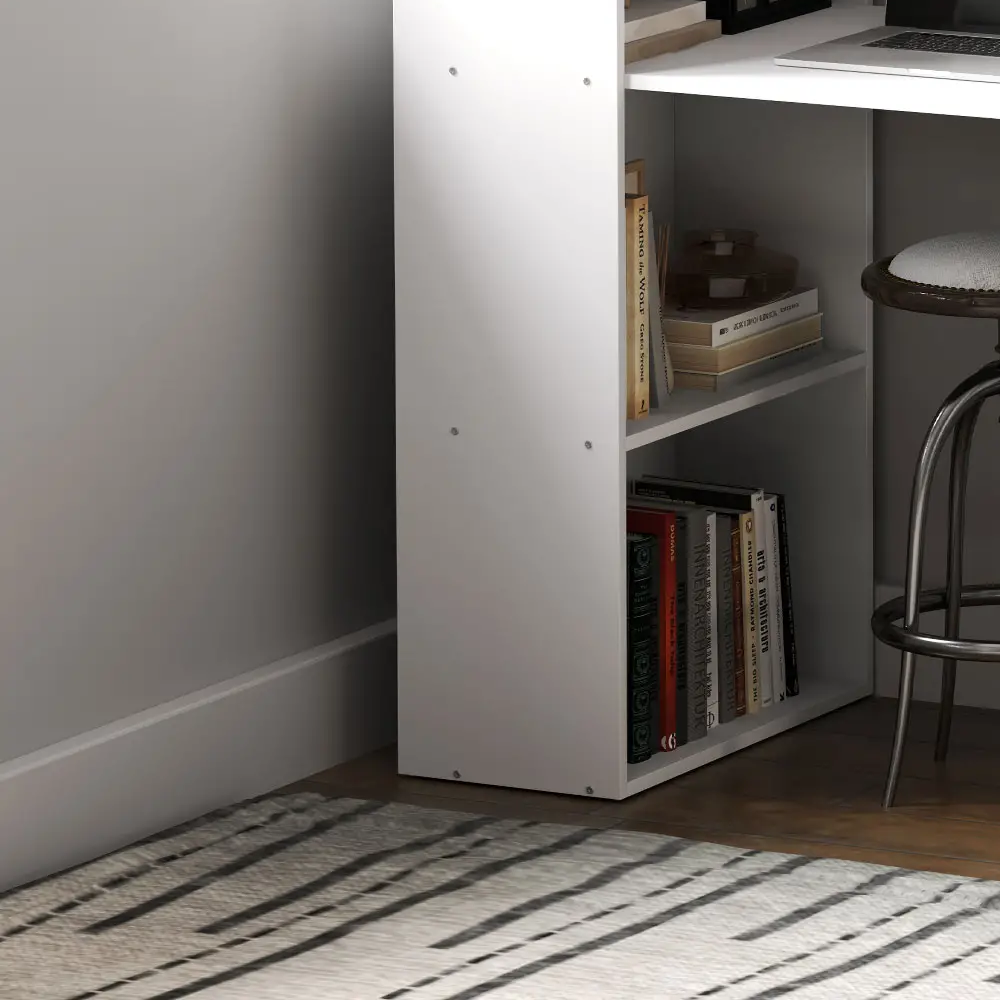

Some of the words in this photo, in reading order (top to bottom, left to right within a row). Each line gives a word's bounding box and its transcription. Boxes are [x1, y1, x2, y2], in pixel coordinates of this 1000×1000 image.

[638, 203, 646, 258] TAMING
[638, 262, 646, 276] the
[638, 276, 646, 316] WOLF
[748, 588, 756, 632] RAYMOND
